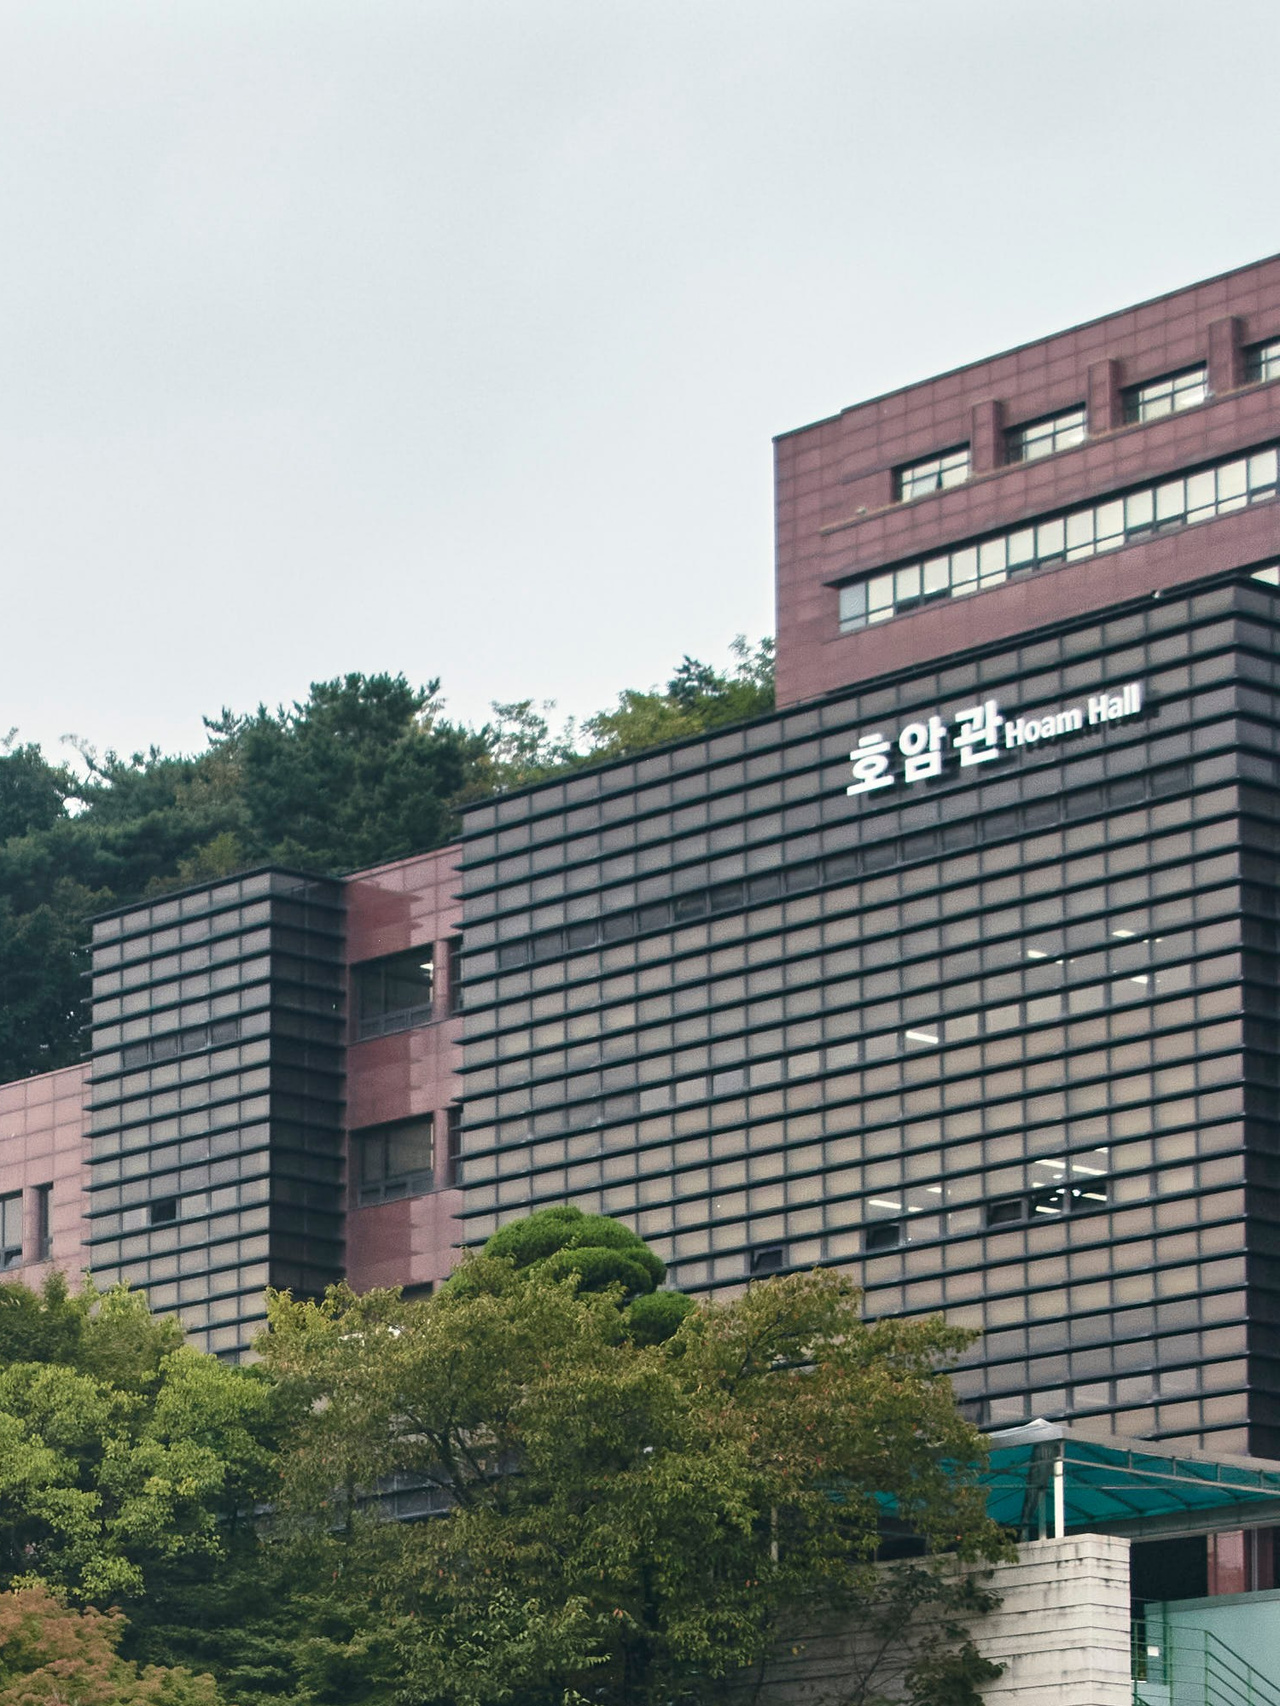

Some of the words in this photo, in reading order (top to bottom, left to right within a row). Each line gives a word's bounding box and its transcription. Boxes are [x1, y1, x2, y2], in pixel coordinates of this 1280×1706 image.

[846, 699, 1004, 797] 호암관
[1004, 707, 1083, 749] Hoam
[1087, 682, 1142, 725] Hall
